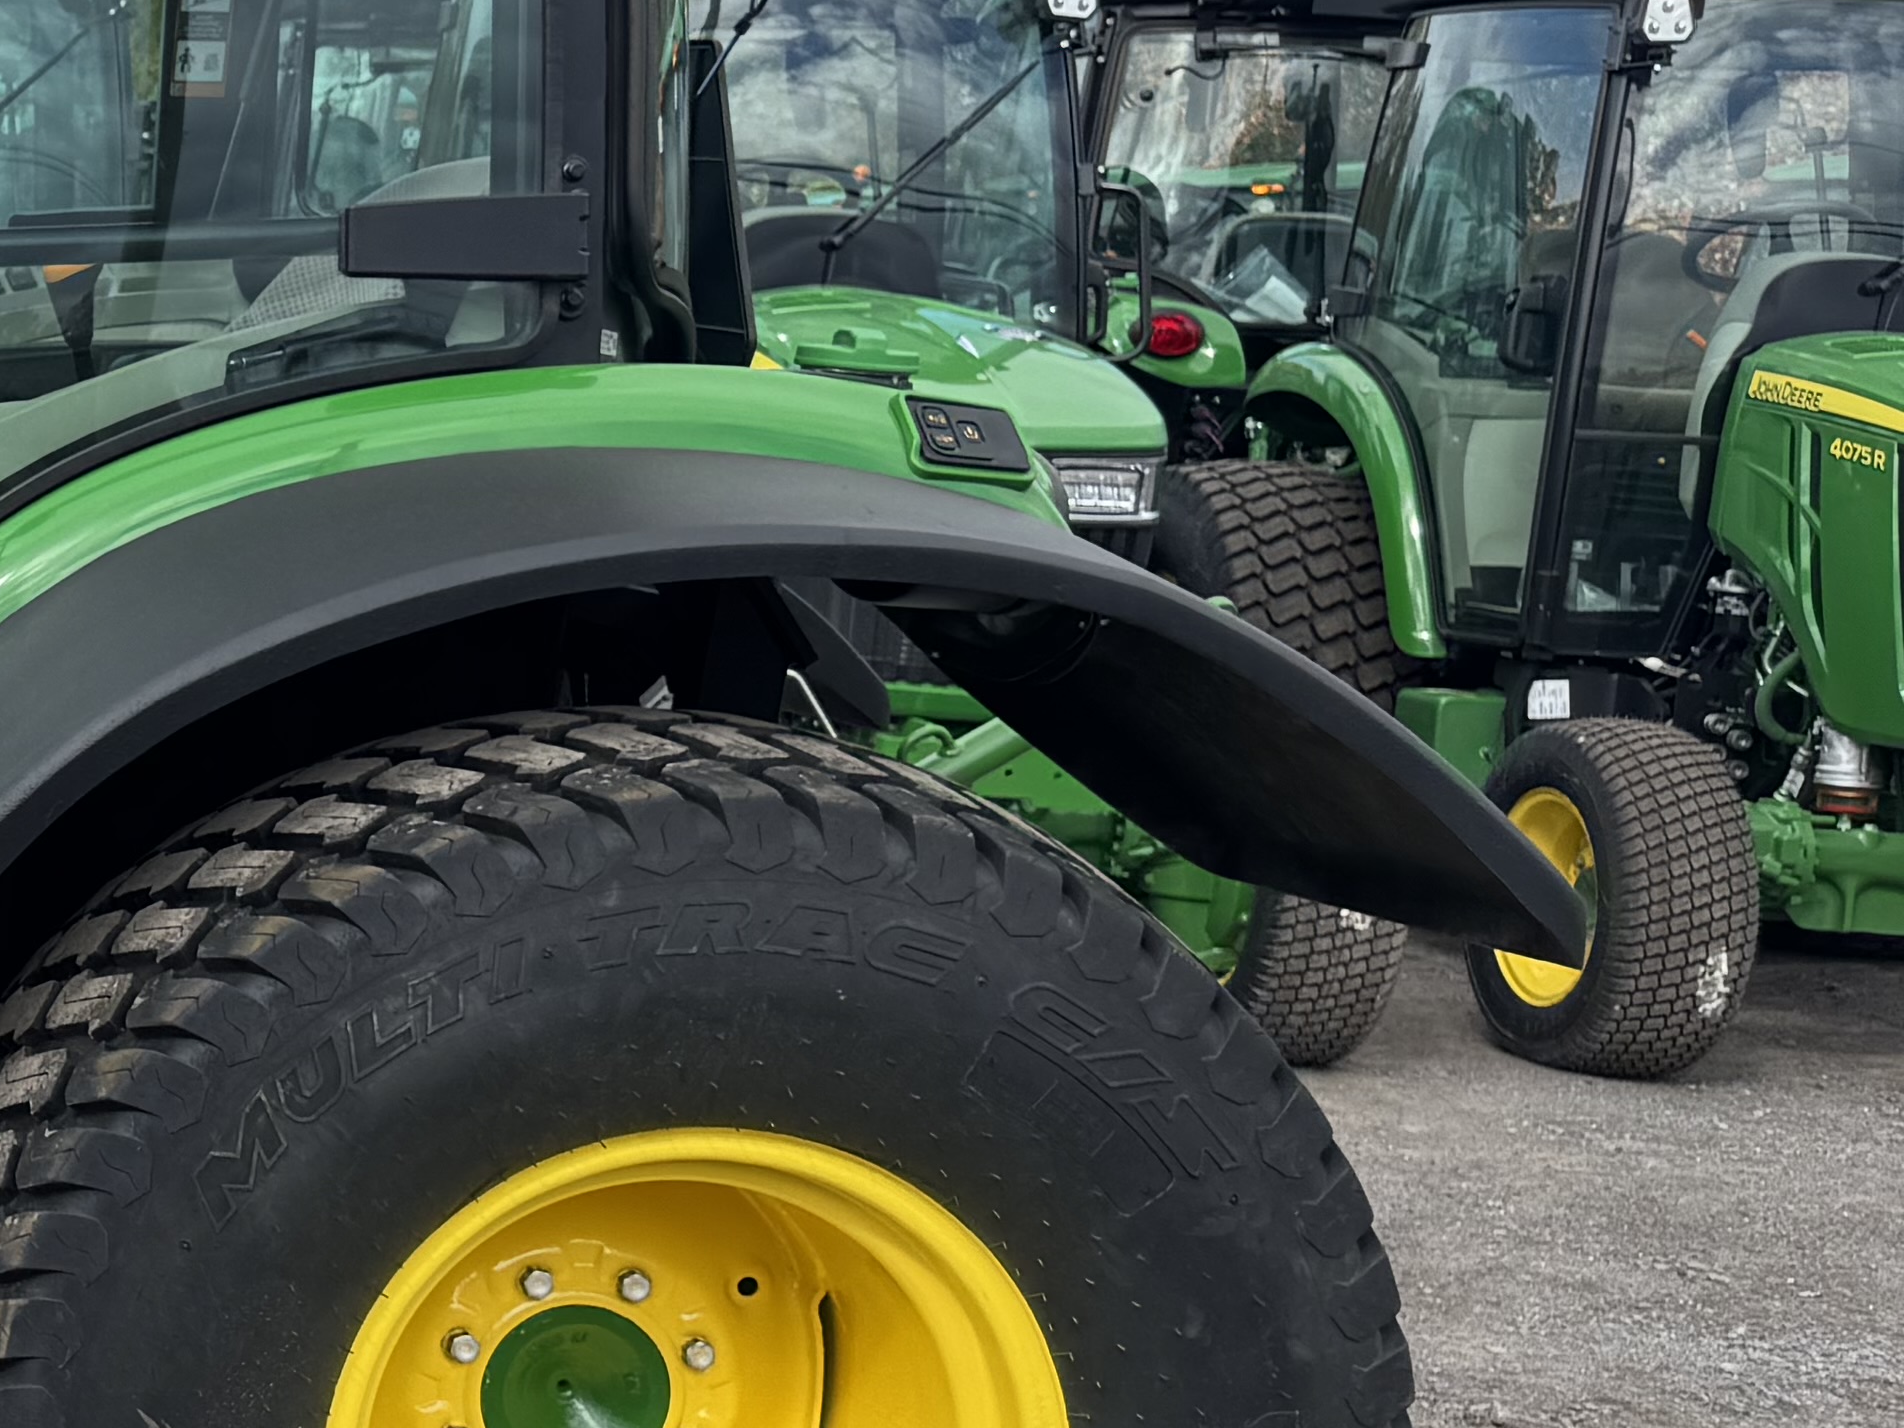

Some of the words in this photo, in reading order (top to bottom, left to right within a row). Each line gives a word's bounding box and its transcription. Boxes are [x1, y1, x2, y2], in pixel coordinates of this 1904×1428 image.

[1751, 375, 1782, 400] JOHN
[1782, 381, 1823, 408] DEERE
[195, 936, 533, 1233] MULTI
[577, 902, 973, 987] TRAC
